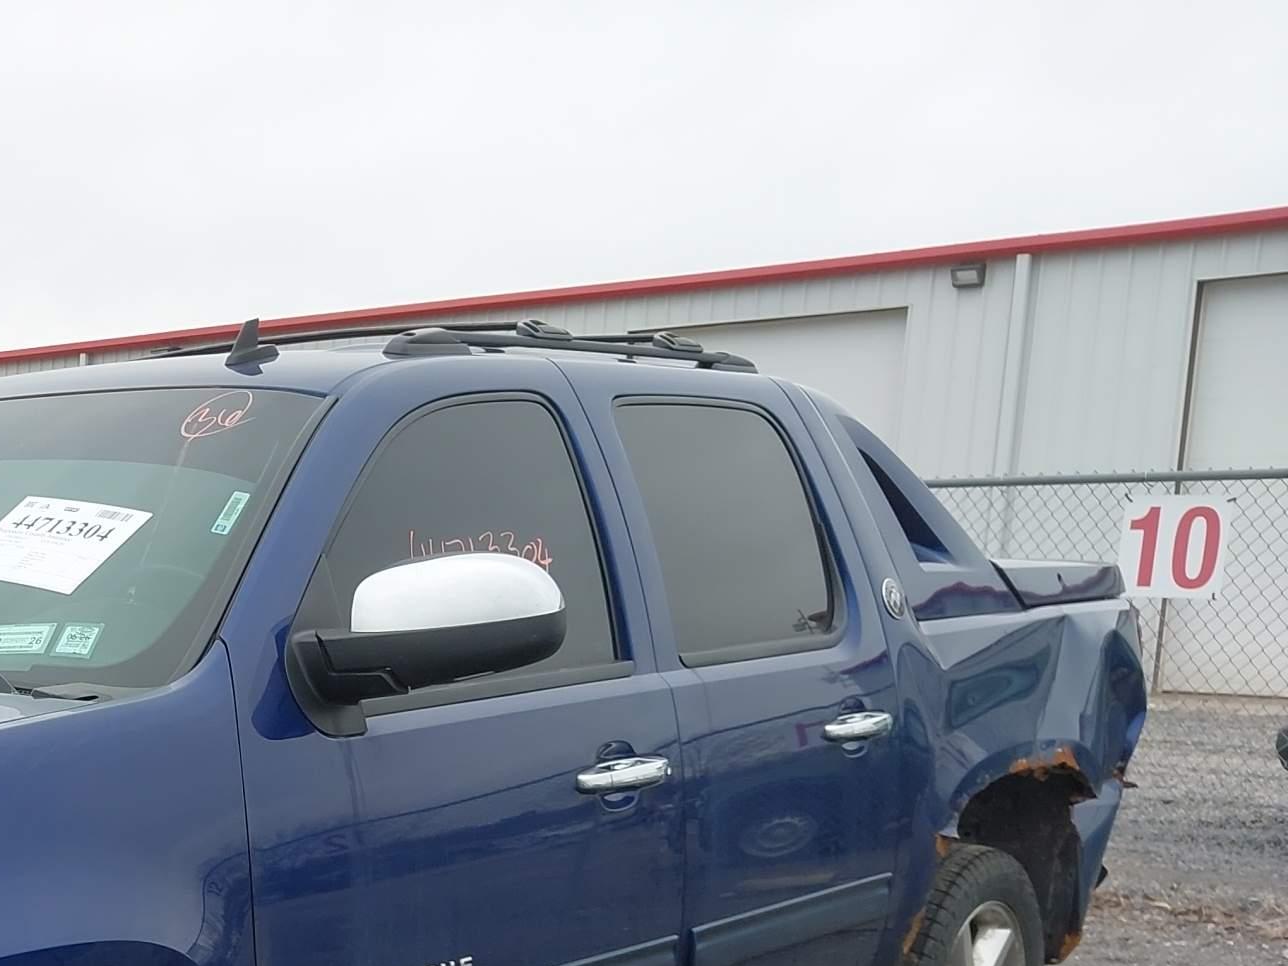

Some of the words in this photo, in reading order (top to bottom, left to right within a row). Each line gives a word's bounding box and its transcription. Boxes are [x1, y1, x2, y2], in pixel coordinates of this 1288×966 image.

[12, 514, 116, 541] 44713304
[1129, 505, 1221, 590] 10
[28, 636, 42, 645] 26
